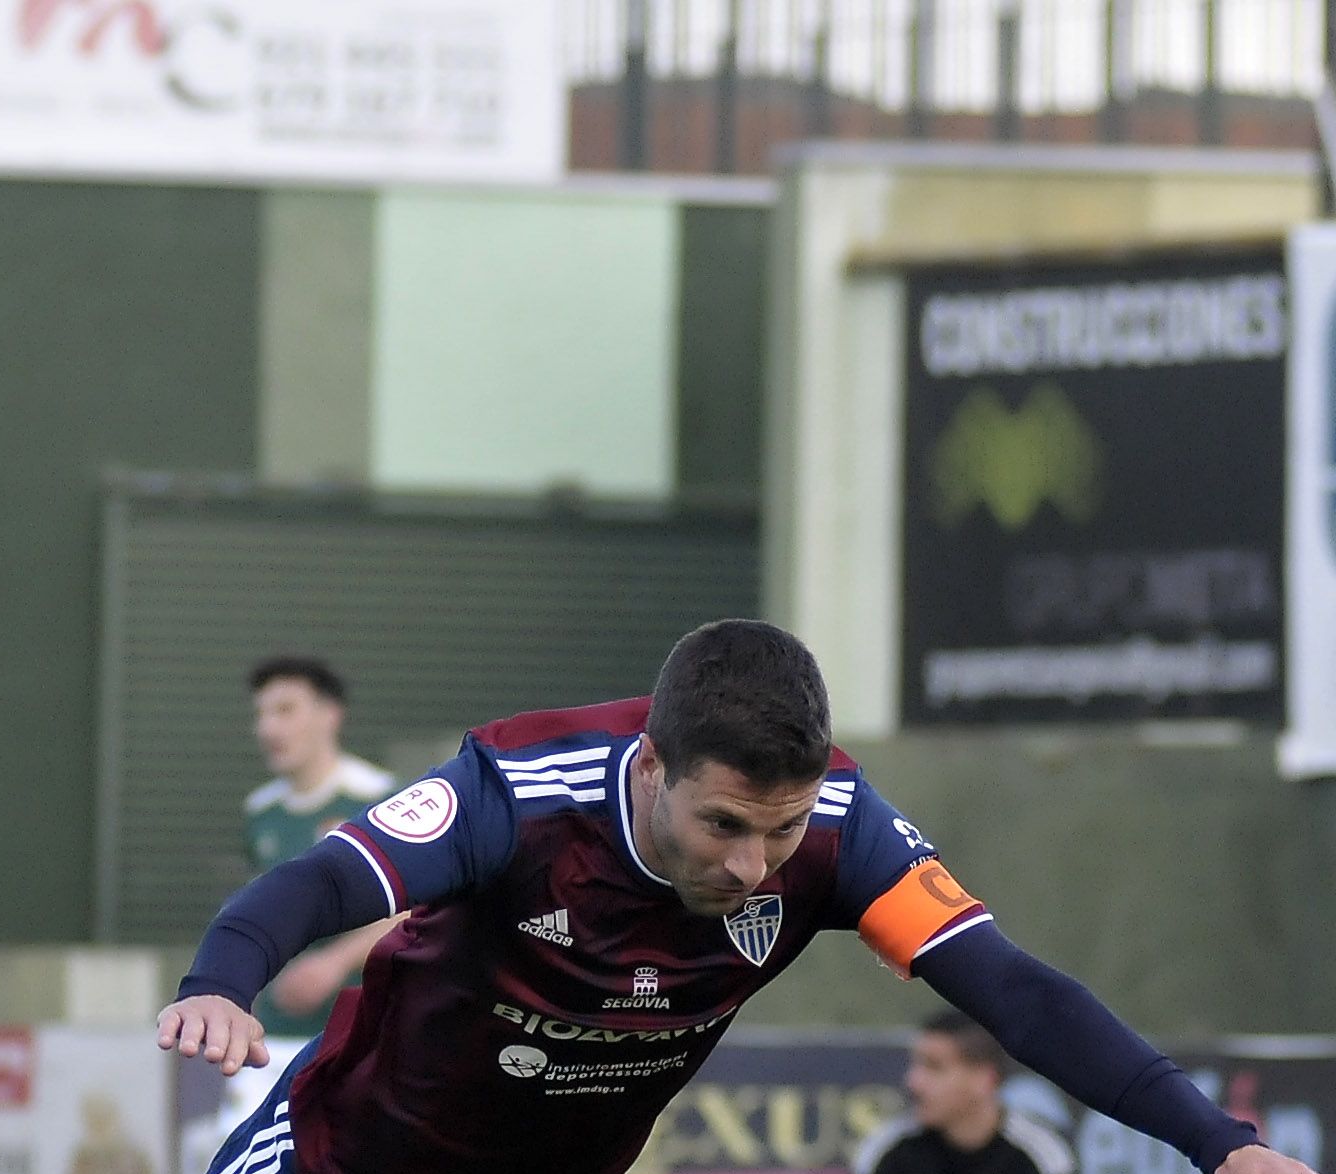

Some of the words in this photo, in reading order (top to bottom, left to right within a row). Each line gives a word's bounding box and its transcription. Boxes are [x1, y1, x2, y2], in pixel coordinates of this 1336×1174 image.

[921, 272, 1286, 376] CONSTRUCCIONES
[517, 920, 575, 947] adidas
[601, 997, 671, 1010] SEGOVIA
[544, 1085, 626, 1097] www.imdsg.es
